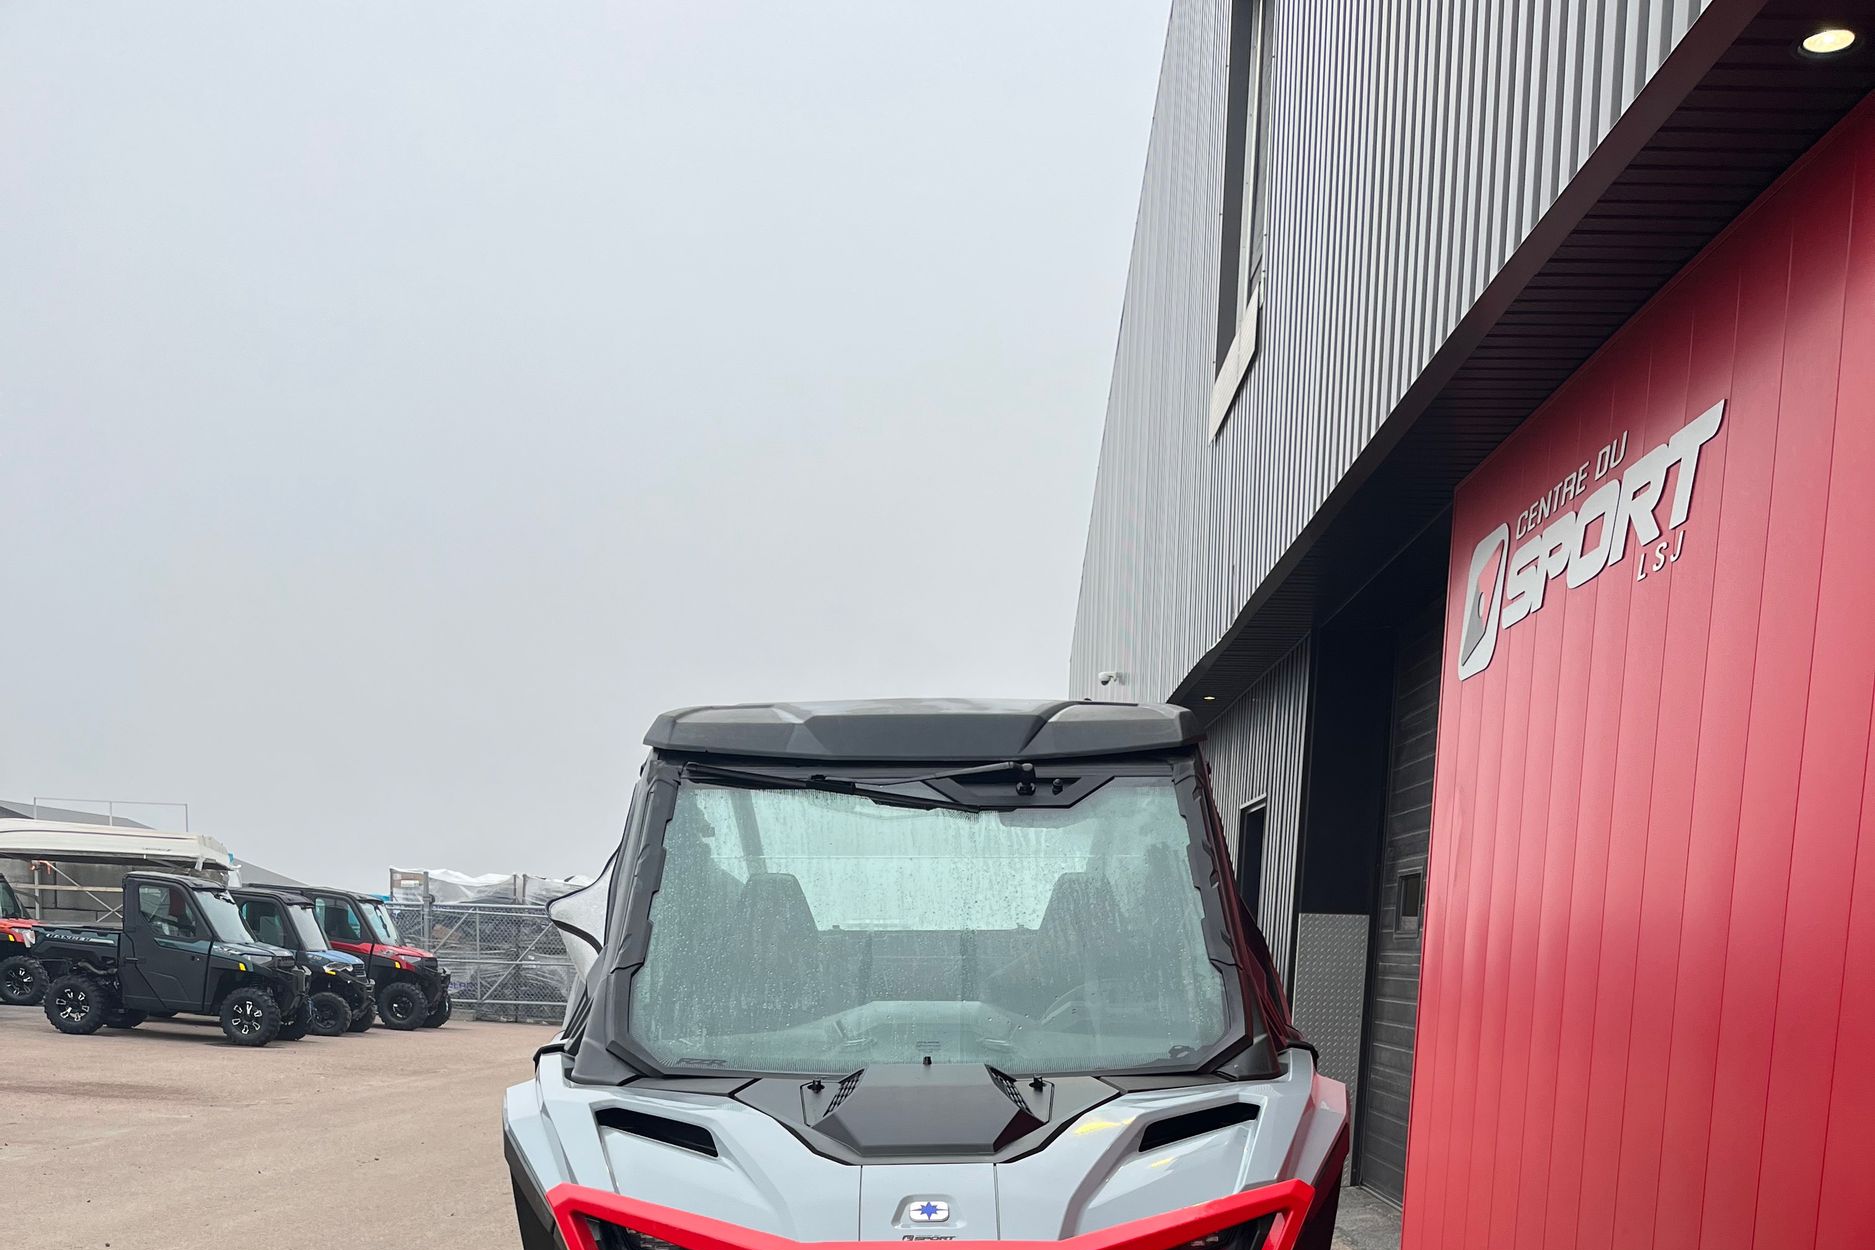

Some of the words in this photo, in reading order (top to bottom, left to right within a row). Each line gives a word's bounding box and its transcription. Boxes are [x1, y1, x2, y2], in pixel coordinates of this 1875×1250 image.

[1502, 398, 1725, 629] SPORT
[1516, 461, 1591, 540] CENTRE
[1595, 430, 1628, 481] DU
